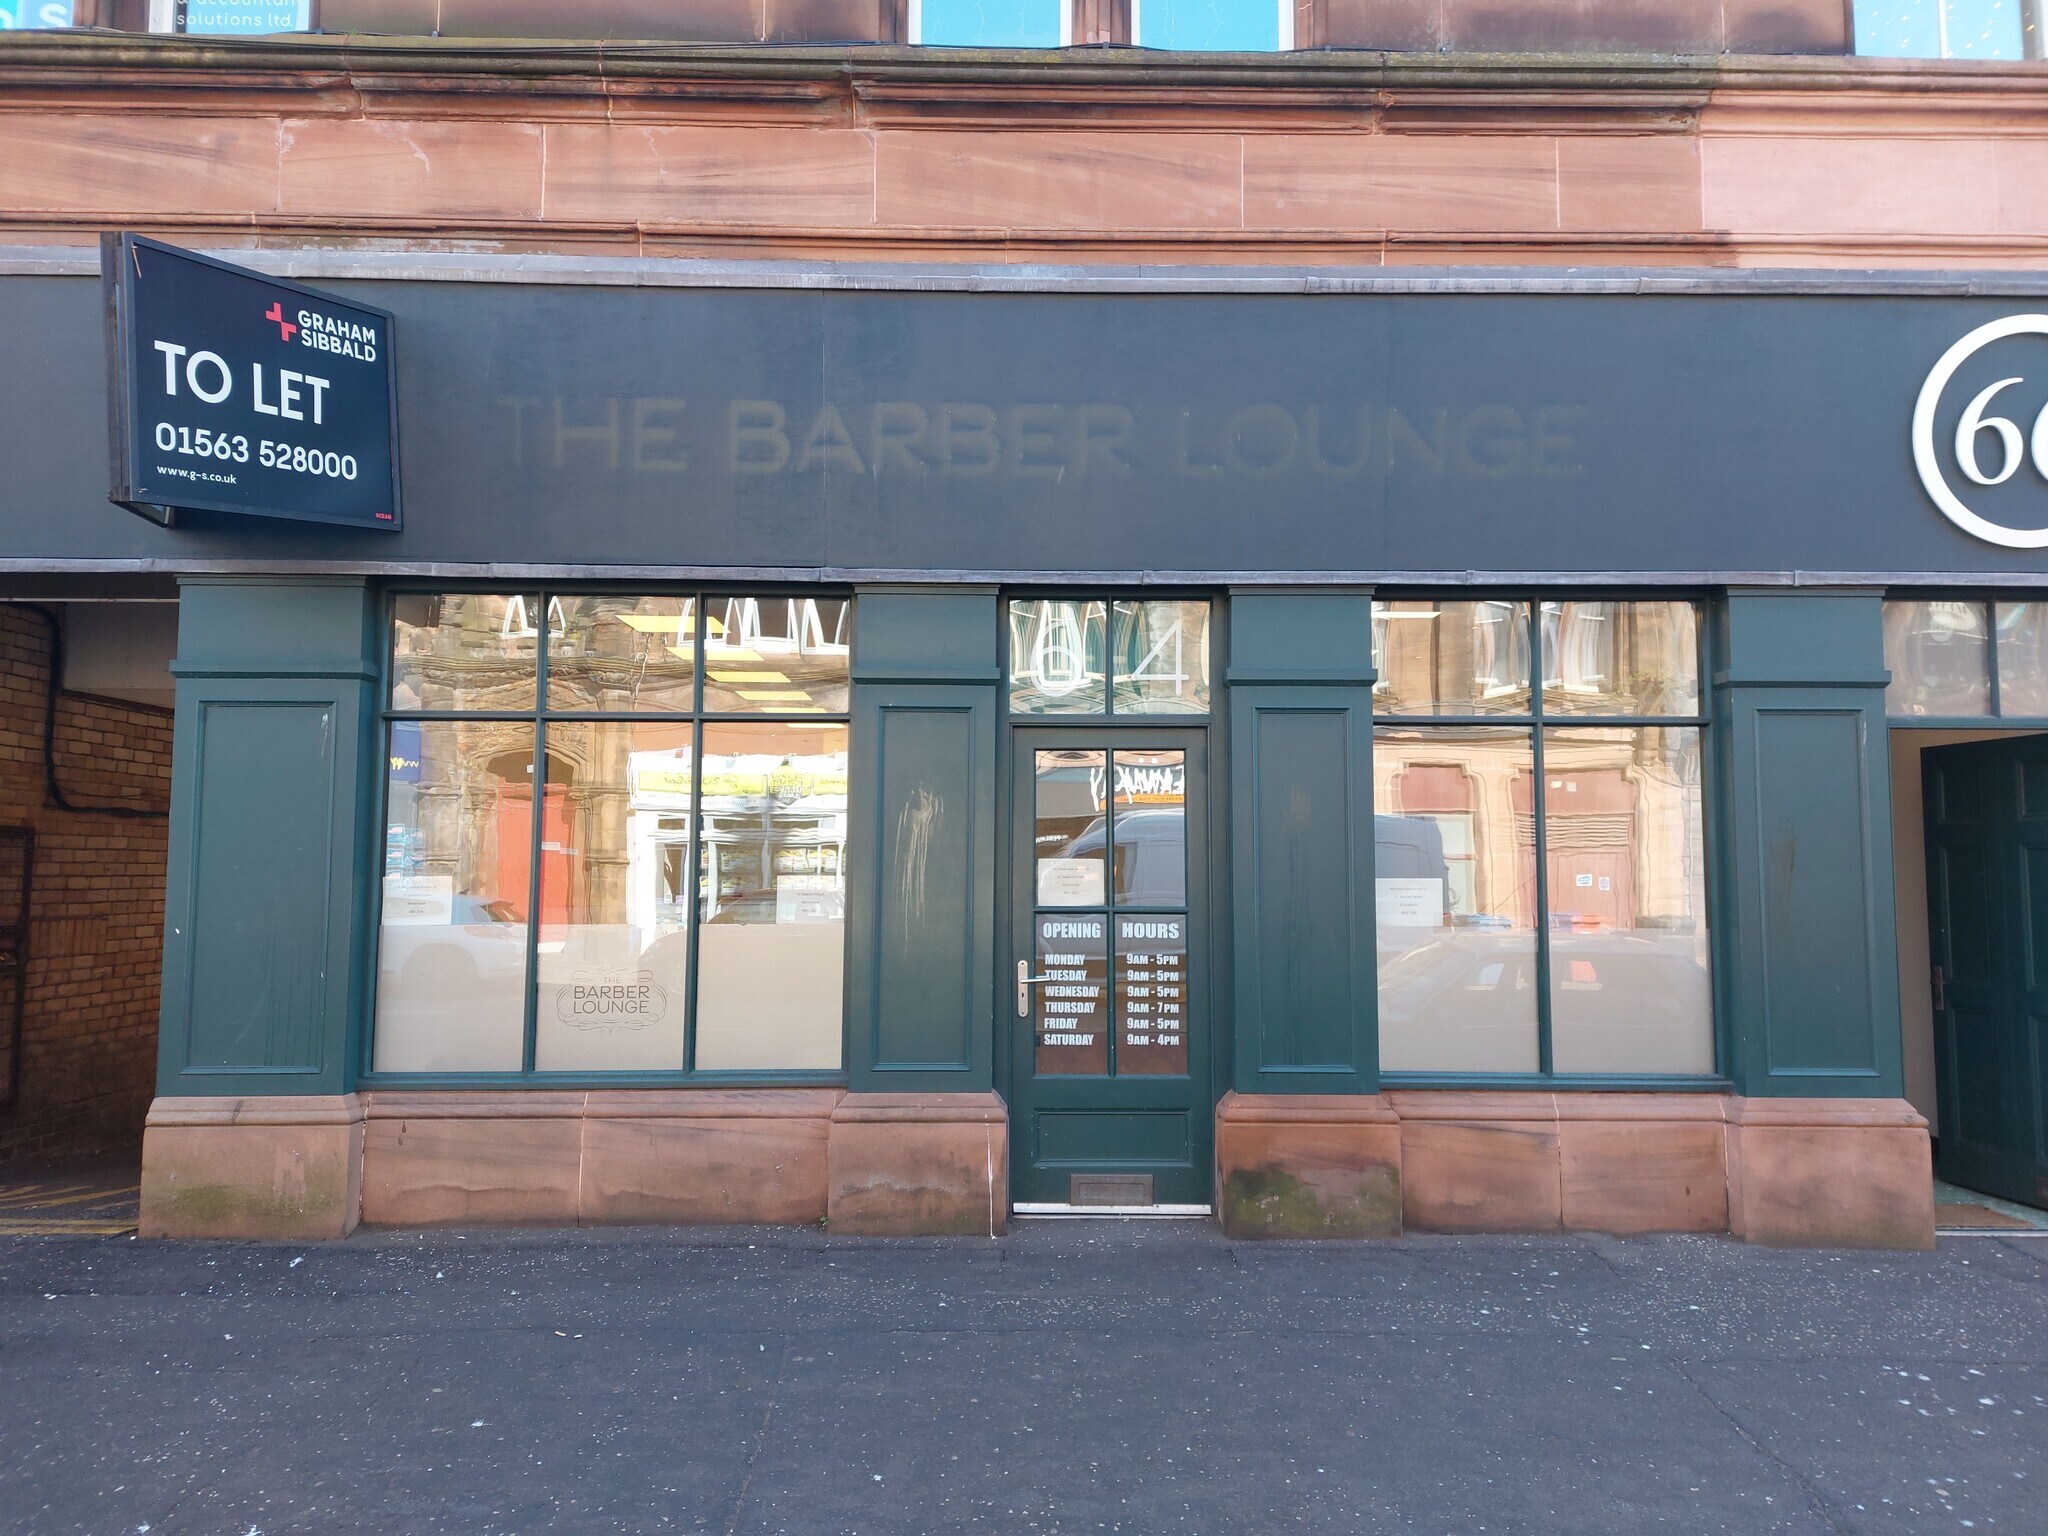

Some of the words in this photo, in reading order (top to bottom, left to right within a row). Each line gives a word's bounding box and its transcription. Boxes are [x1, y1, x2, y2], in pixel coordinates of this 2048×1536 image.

[176, 12, 262, 27] solutions
[267, 12, 293, 27] ltd.
[297, 310, 376, 346] GRAHAM
[301, 329, 376, 362] SIBBALD
[154, 340, 232, 403] TO
[253, 362, 330, 424] LET
[500, 399, 688, 470] THE
[730, 400, 1137, 475] BARBER
[1178, 403, 1588, 479] LOUNGE
[155, 422, 249, 463] 01563
[259, 440, 357, 480] 528000
[157, 464, 237, 484] www.g-s.co.uk
[1043, 922, 1101, 939] OPENING
[1122, 922, 1180, 939] HOURS
[1044, 954, 1085, 965] MONDAY
[1126, 953, 1149, 965] 9AM
[1156, 953, 1179, 965] 5PM
[603, 976, 621, 984] THE
[1044, 970, 1087, 981] TUESDAY
[1126, 969, 1149, 981] 9AM
[1156, 969, 1179, 981] 5PM
[573, 985, 650, 999] BARBER
[1044, 986, 1099, 997] WEDNESDAY
[1126, 985, 1149, 997] 9AM
[1156, 985, 1179, 997] 5PM
[573, 1000, 650, 1014] LOUNGE
[1044, 1002, 1096, 1013] THURSDAY
[1126, 1001, 1149, 1013] 9AM
[1156, 1001, 1179, 1013] 7PM
[1043, 1018, 1078, 1029] FRIDAY
[1126, 1017, 1149, 1029] 9AM
[1156, 1017, 1179, 1029] 5PM
[1044, 1034, 1094, 1045] SATURDAY
[1126, 1033, 1149, 1045] 9AM
[1156, 1033, 1179, 1045] 4PM
